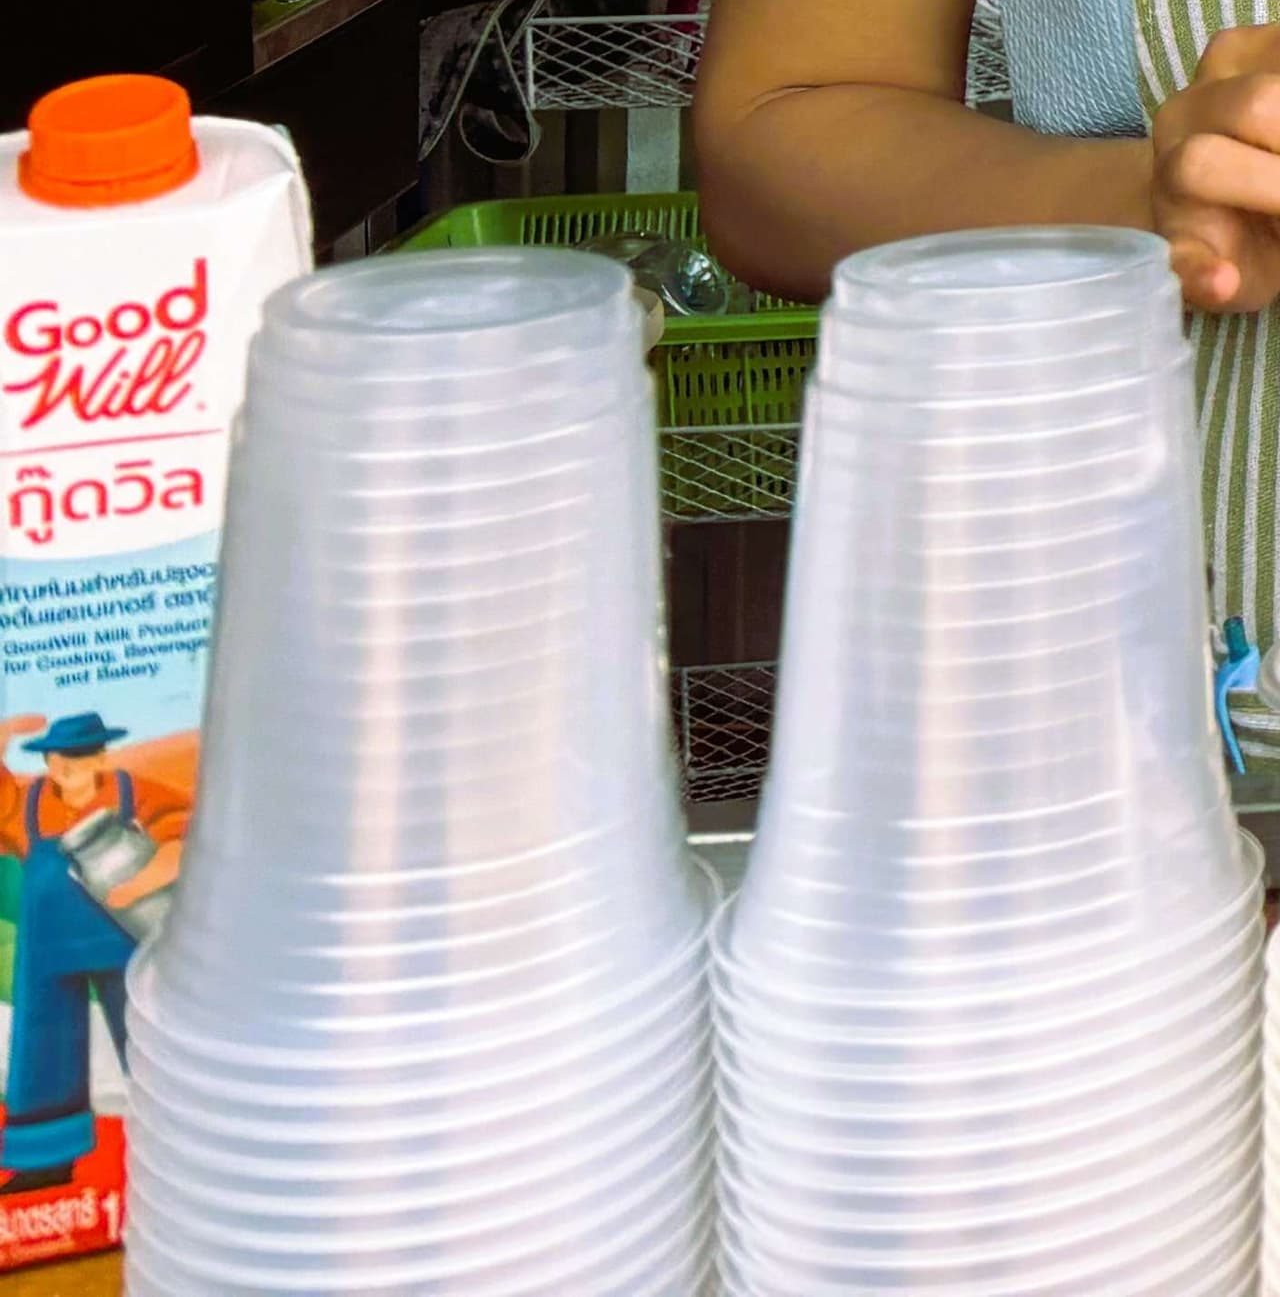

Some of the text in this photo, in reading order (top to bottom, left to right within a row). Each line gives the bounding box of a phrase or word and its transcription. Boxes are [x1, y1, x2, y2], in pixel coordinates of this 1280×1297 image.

[5, 257, 207, 356] Good
[3, 329, 206, 429] Will
[8, 459, 203, 545] กู๊ดวิล
[94, 626, 130, 644] Milk
